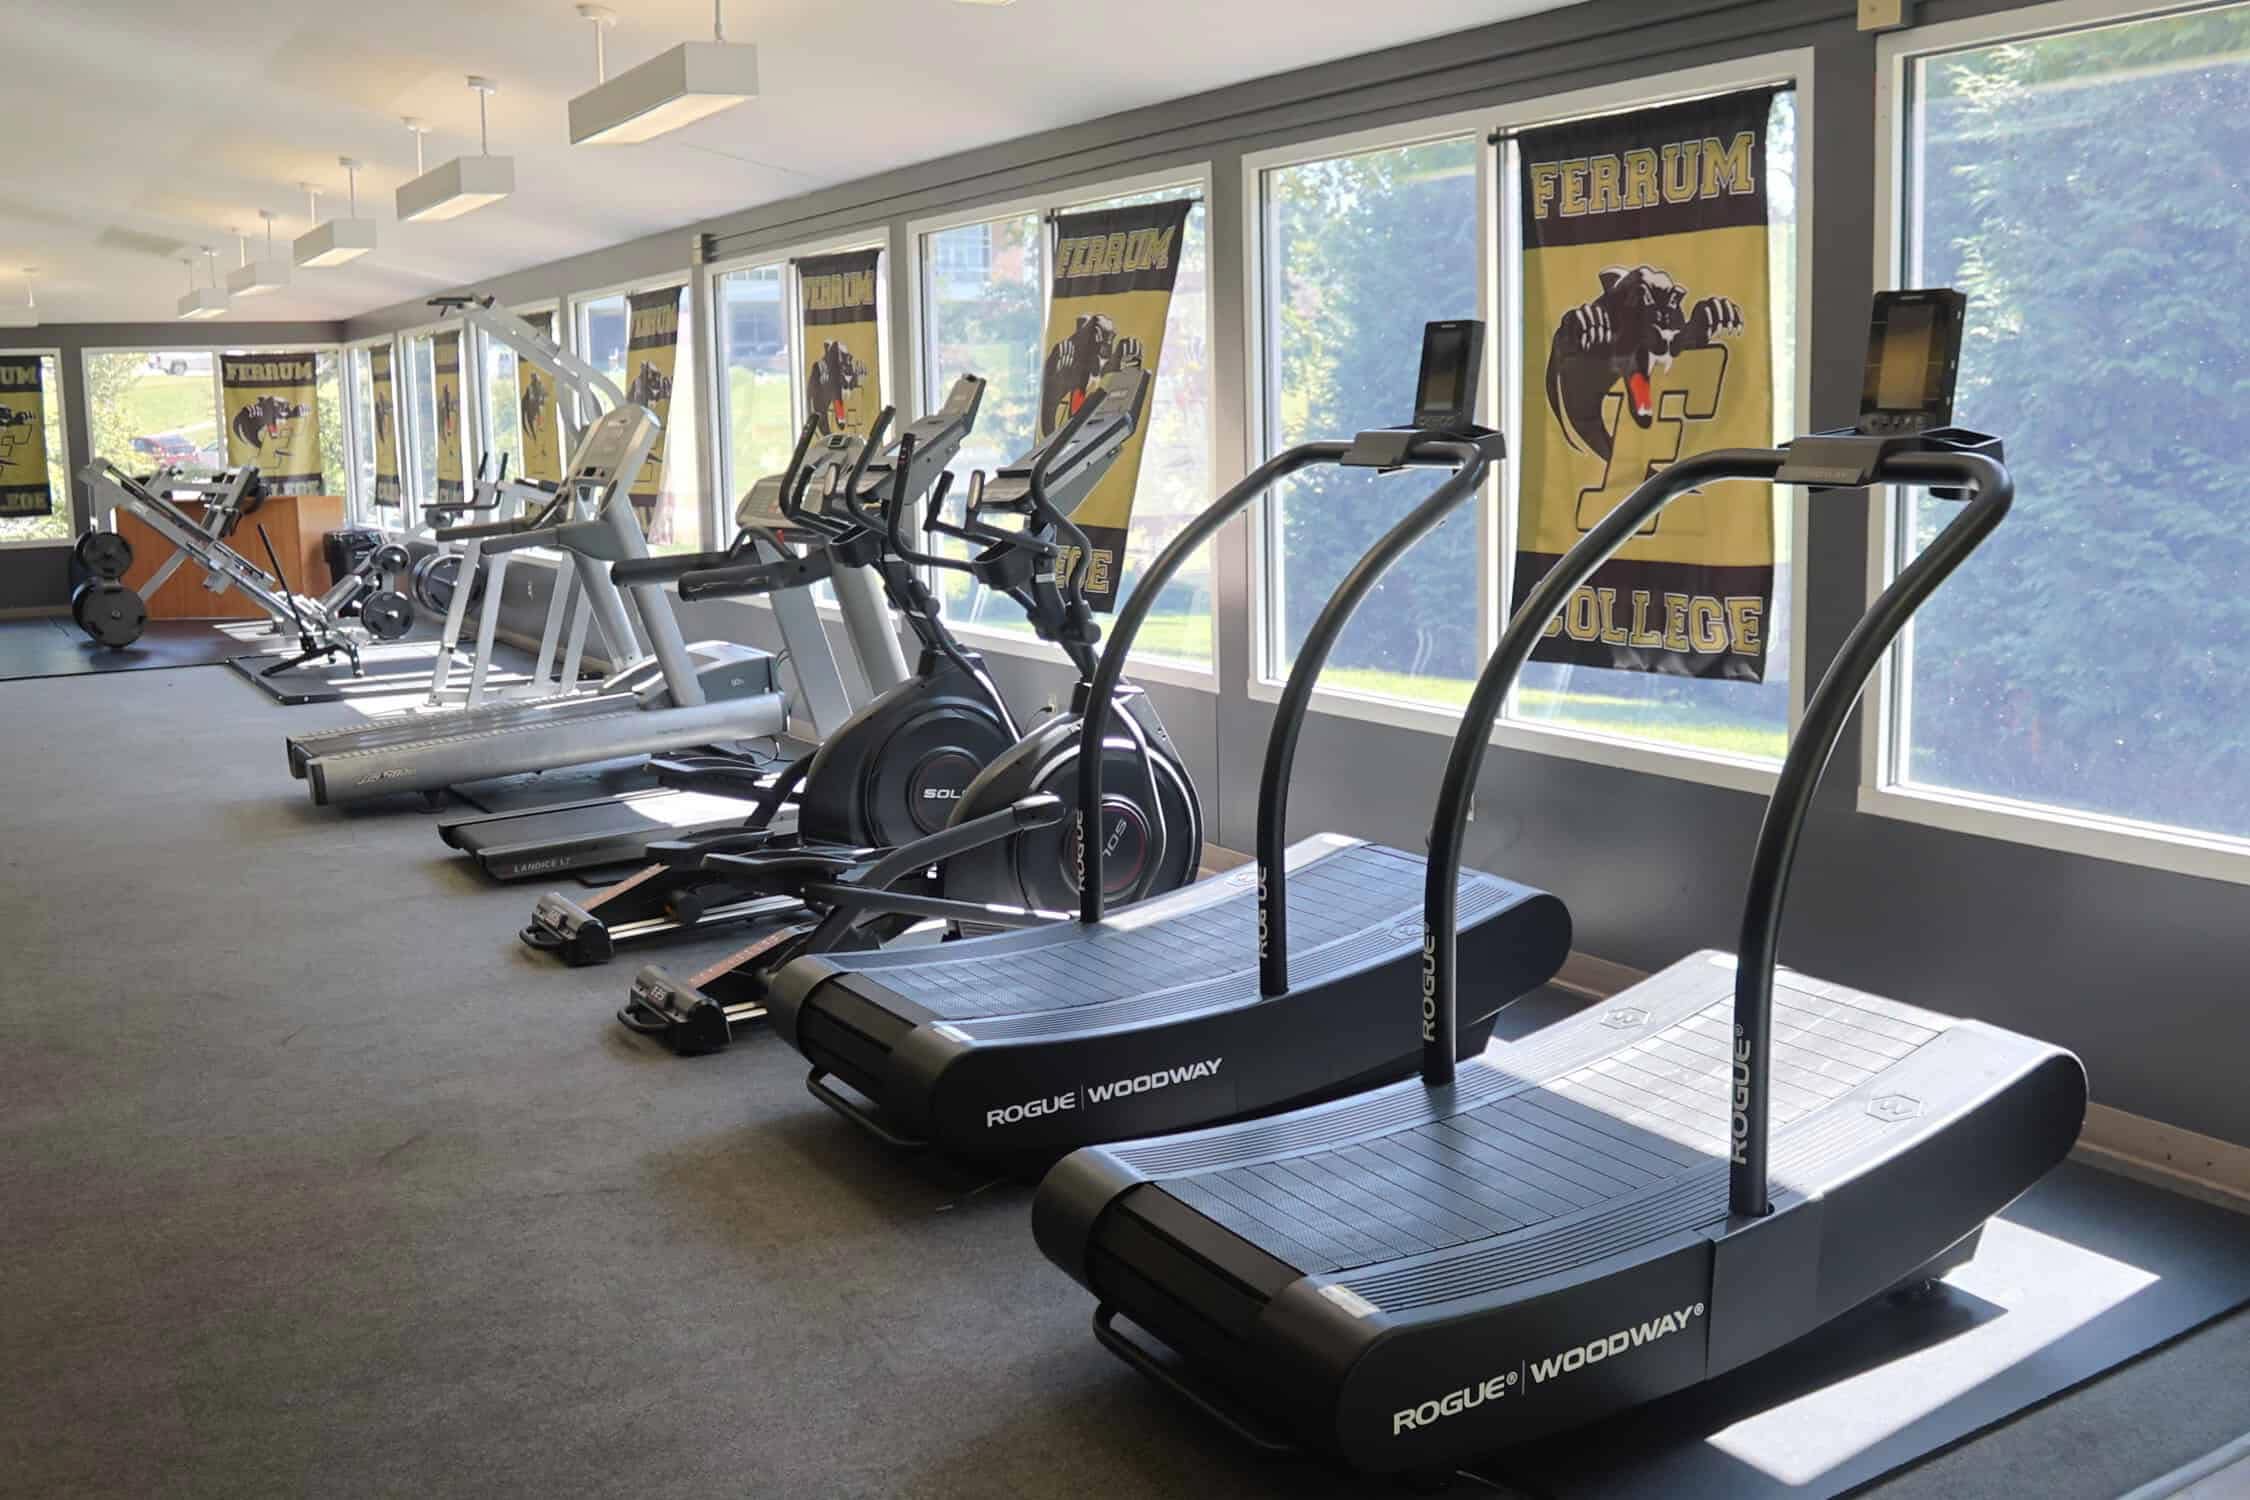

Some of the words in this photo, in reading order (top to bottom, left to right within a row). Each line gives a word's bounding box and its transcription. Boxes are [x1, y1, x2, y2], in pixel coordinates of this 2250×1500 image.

[1529, 130, 1755, 220] FERRUM
[1056, 225, 1176, 279] FERRUM
[513, 857, 556, 874] LANDICE
[987, 1091, 1077, 1129] ROGUE
[1088, 1057, 1223, 1105] WOODWAY
